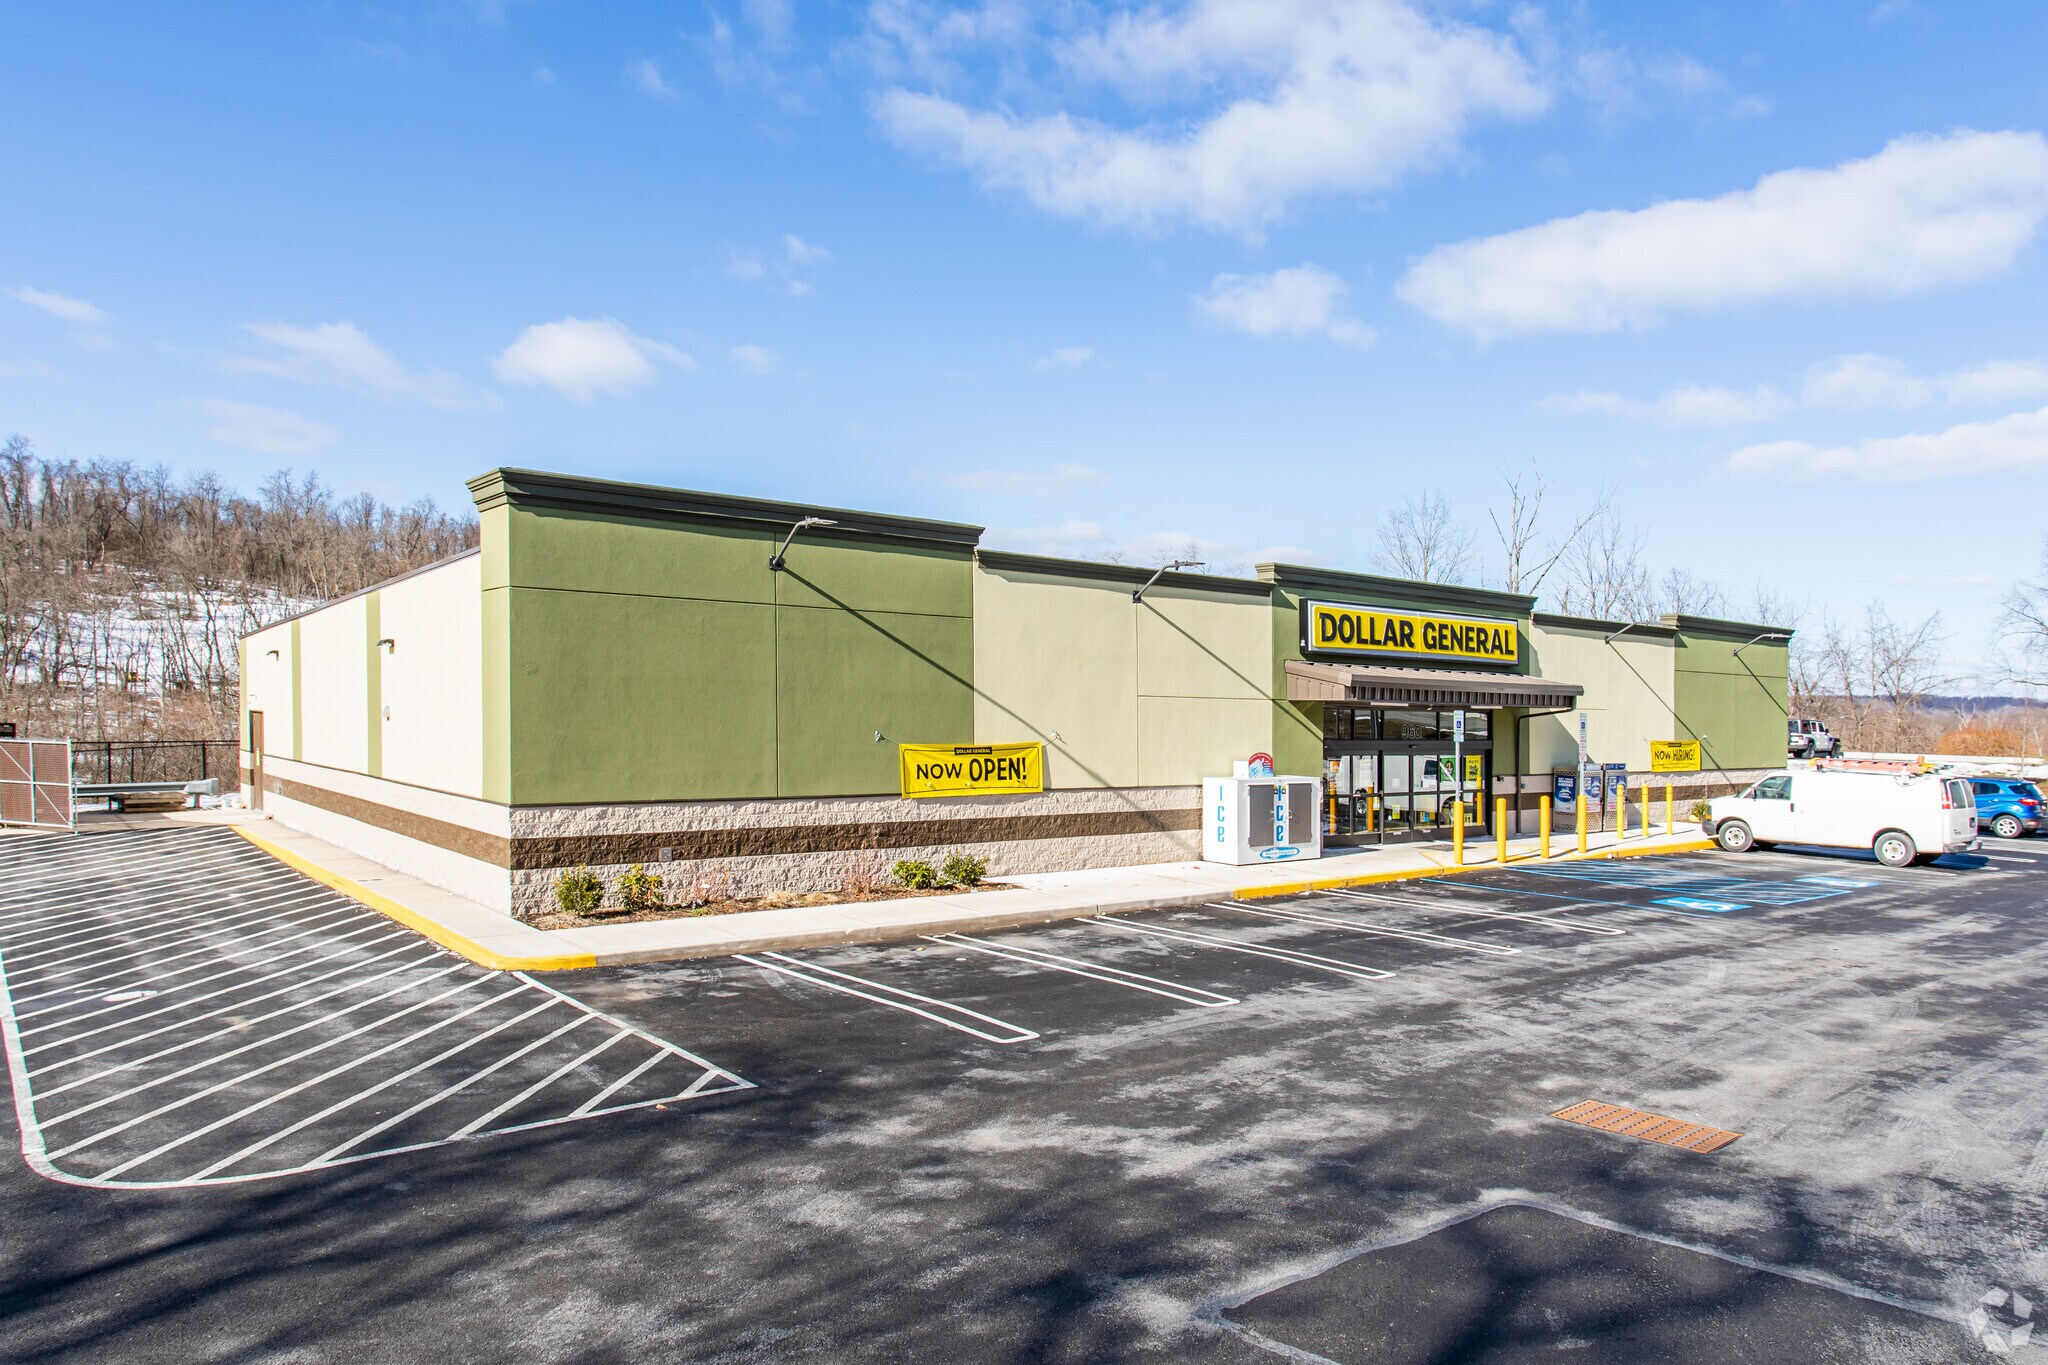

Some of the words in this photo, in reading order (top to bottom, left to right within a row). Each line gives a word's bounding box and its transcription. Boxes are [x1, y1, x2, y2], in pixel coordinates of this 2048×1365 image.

[1319, 612, 1415, 648] DOLLAR
[1422, 621, 1515, 656] GENERAL
[1654, 750, 1671, 760] NOW
[1672, 748, 1695, 761] HIRING!
[916, 763, 963, 780] NOW
[969, 757, 1027, 782] OPEN!
